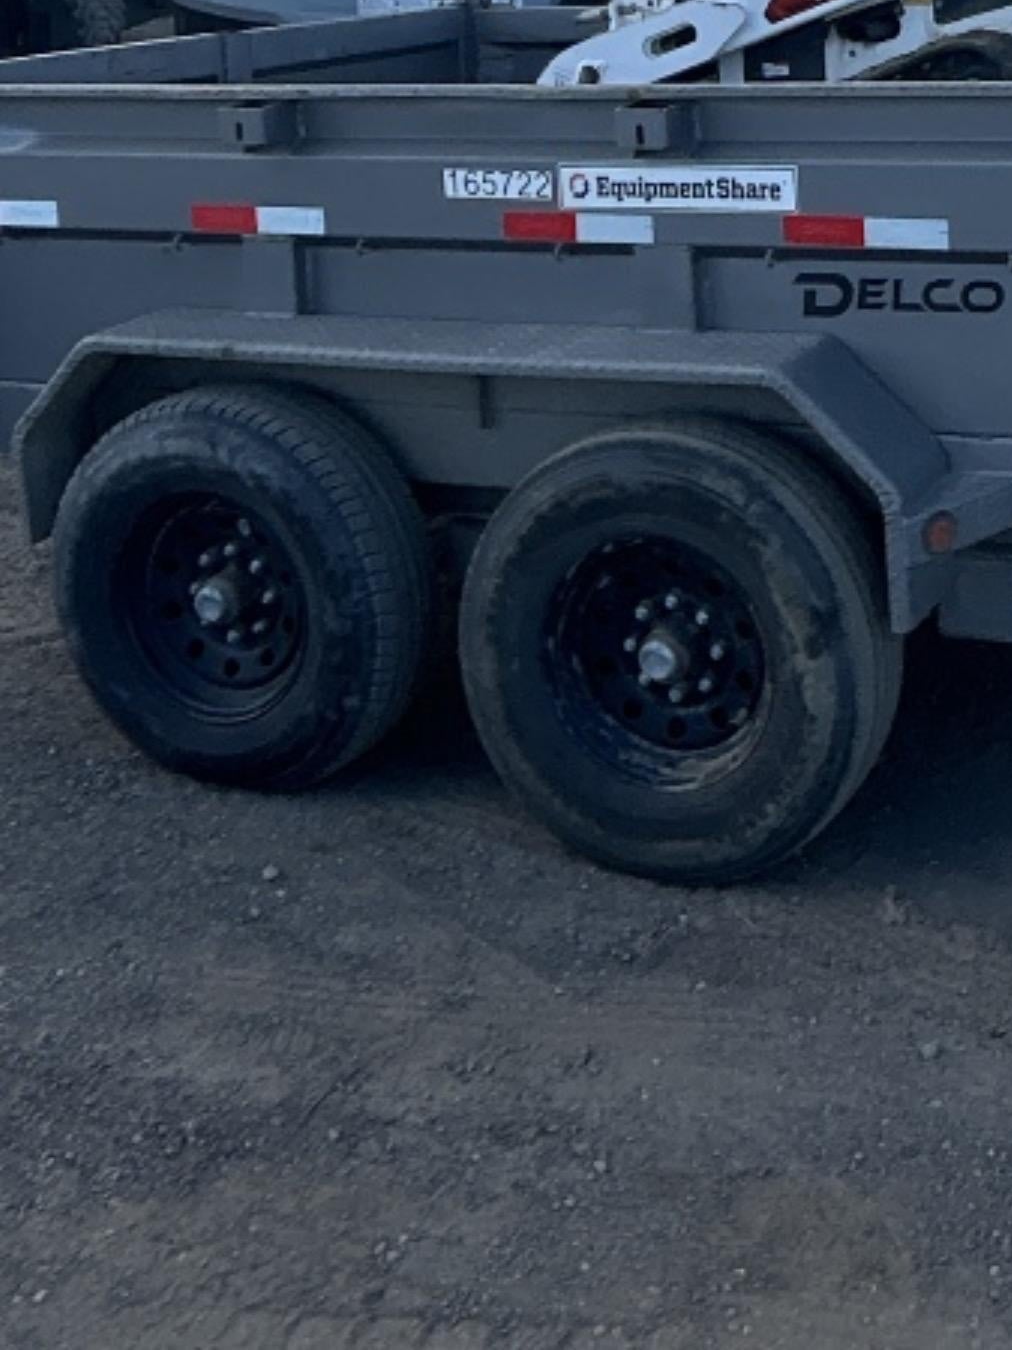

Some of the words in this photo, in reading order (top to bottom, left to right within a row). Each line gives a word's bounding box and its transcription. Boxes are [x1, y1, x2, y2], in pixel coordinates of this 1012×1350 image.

[449, 169, 551, 199] 165722
[596, 176, 783, 202] EquipmentShare
[793, 272, 1005, 317] DELCO
